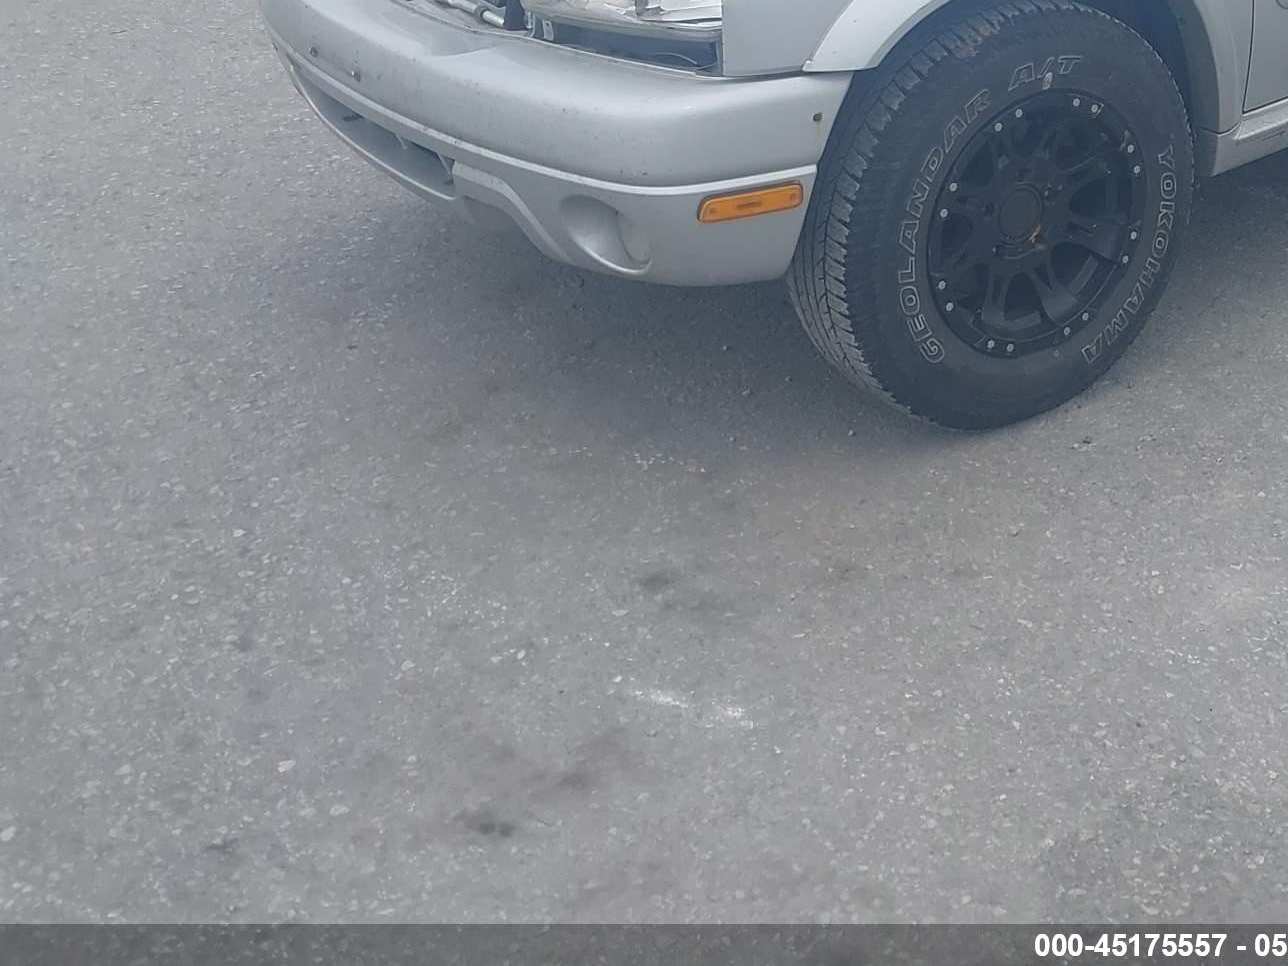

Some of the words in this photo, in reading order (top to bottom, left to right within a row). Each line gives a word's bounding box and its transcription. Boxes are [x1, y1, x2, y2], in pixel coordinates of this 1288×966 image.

[897, 89, 991, 364] GEOLANDAR
[1007, 54, 1084, 92] A/T
[1081, 144, 1178, 364] YOKOHAMA
